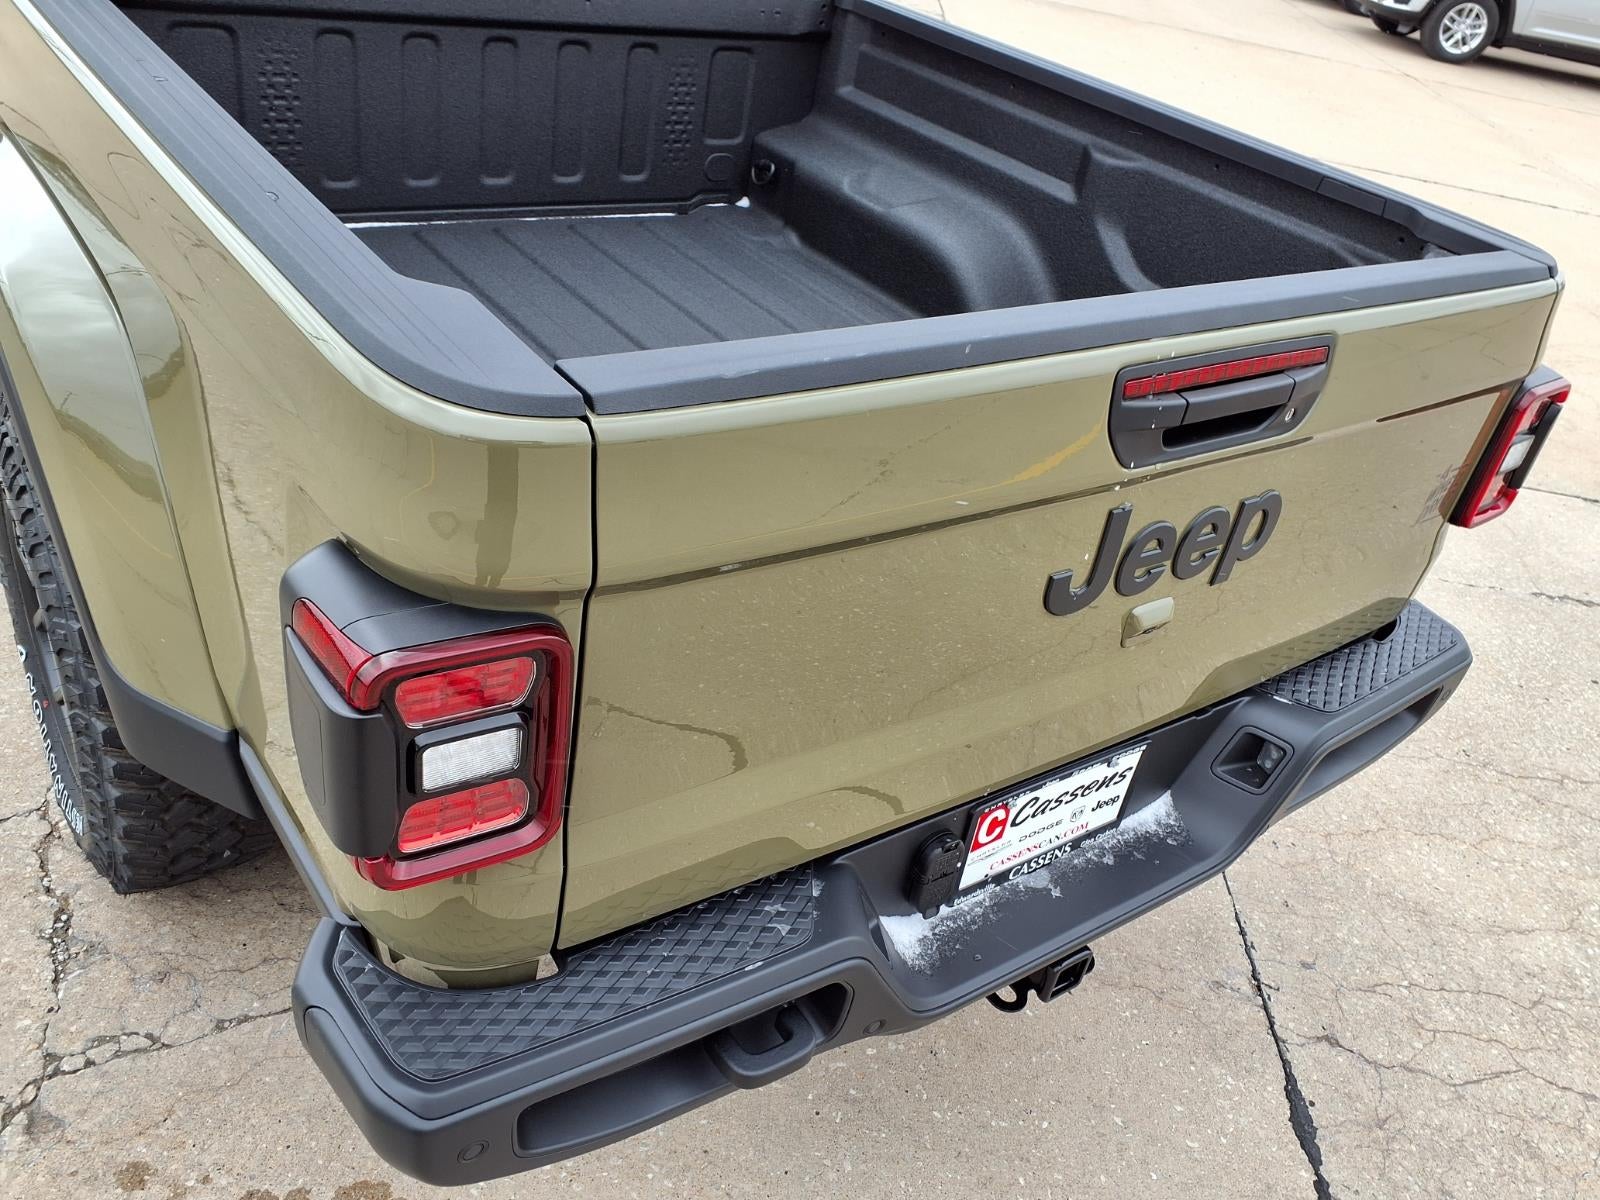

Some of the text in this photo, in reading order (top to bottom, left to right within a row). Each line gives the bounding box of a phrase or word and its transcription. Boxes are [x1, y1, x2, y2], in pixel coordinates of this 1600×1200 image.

[1043, 489, 1283, 616] Jeep
[1010, 766, 1134, 828] Cassens
[1091, 794, 1120, 812] Jeep
[978, 808, 1009, 844] C
[1018, 818, 1064, 842] DODGE
[989, 821, 1089, 871] CASSENSCAN.COM
[1008, 842, 1073, 880] CASSENS
